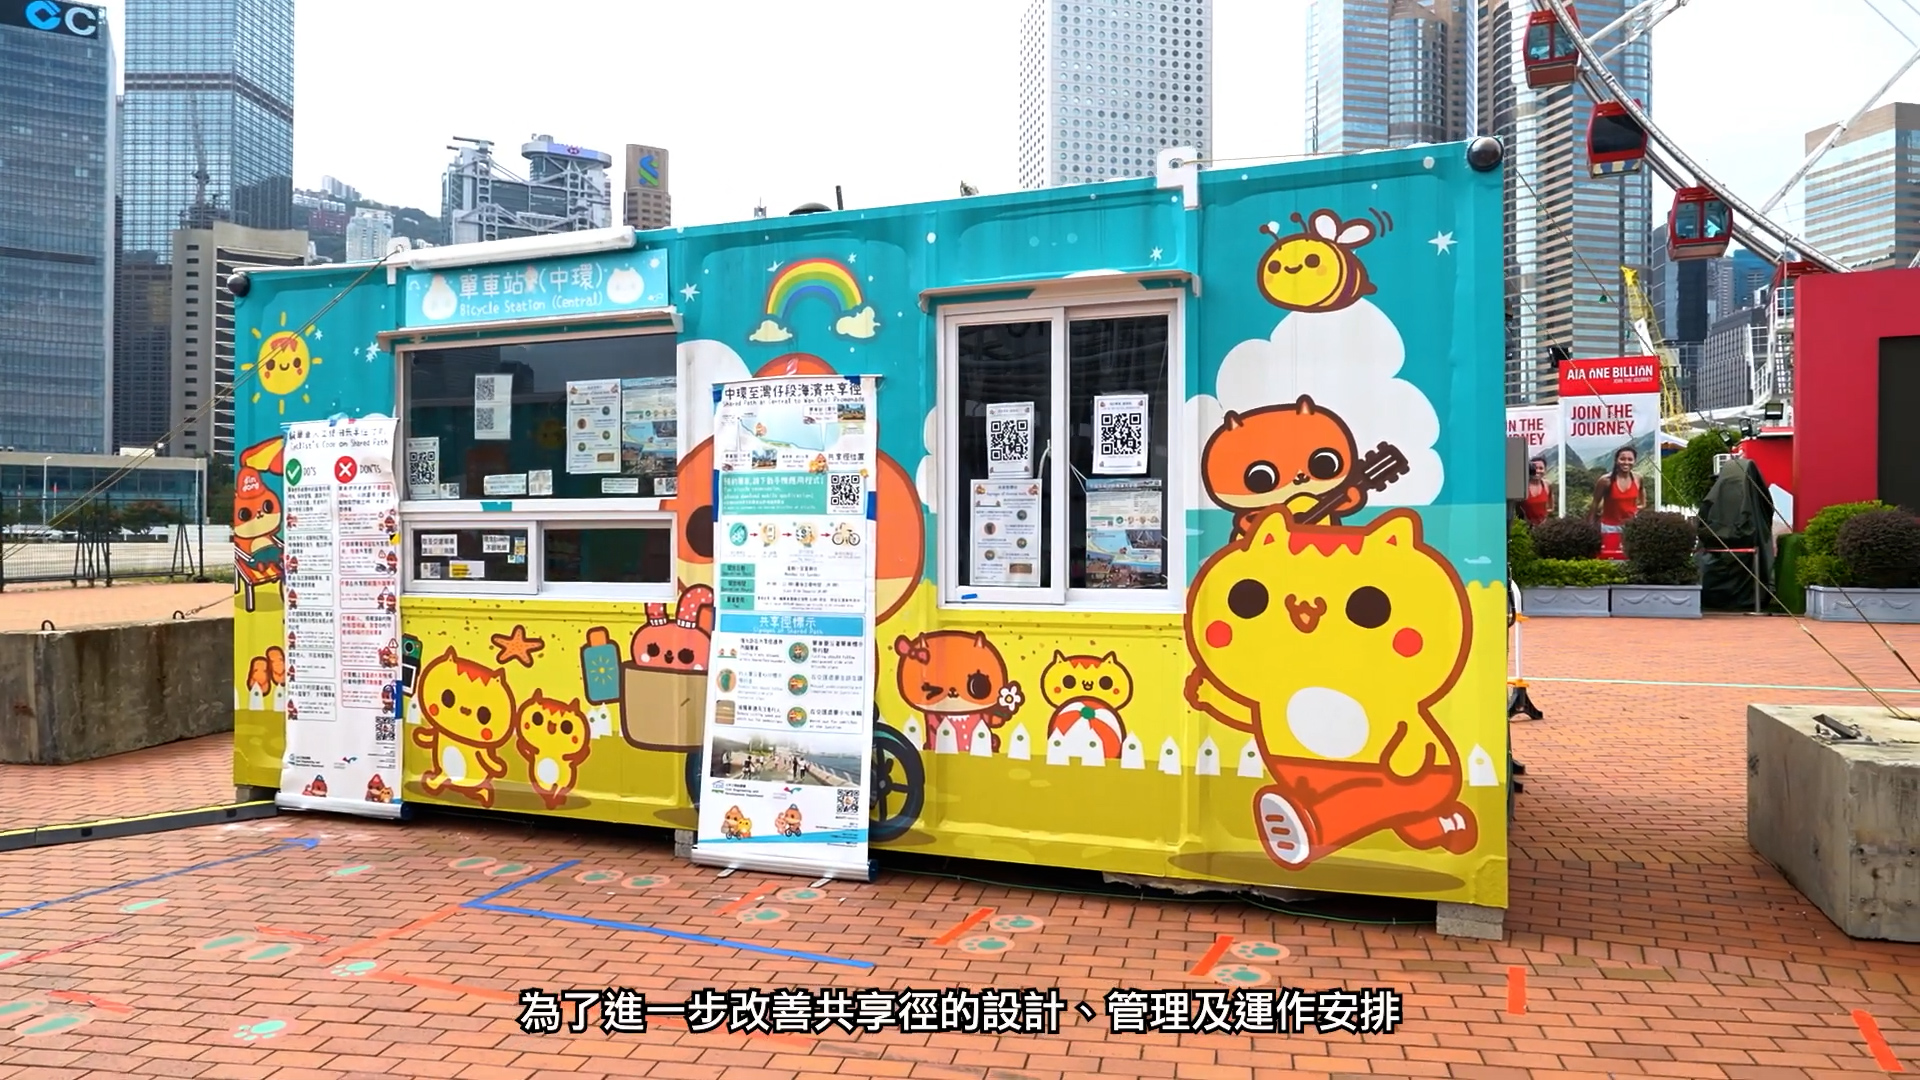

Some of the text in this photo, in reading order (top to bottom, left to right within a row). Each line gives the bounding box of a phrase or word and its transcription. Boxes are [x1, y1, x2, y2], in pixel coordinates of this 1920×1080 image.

[460, 291, 603, 317] Bicycle Station (Central)
[1567, 368, 1586, 380] AIA
[1612, 365, 1653, 378] BILLION
[724, 382, 862, 400] 中環至灣仔段海濱共享徑
[1571, 404, 1633, 420] JOIN THE
[1519, 418, 1544, 432] THE
[1570, 420, 1635, 436] JOURNEY
